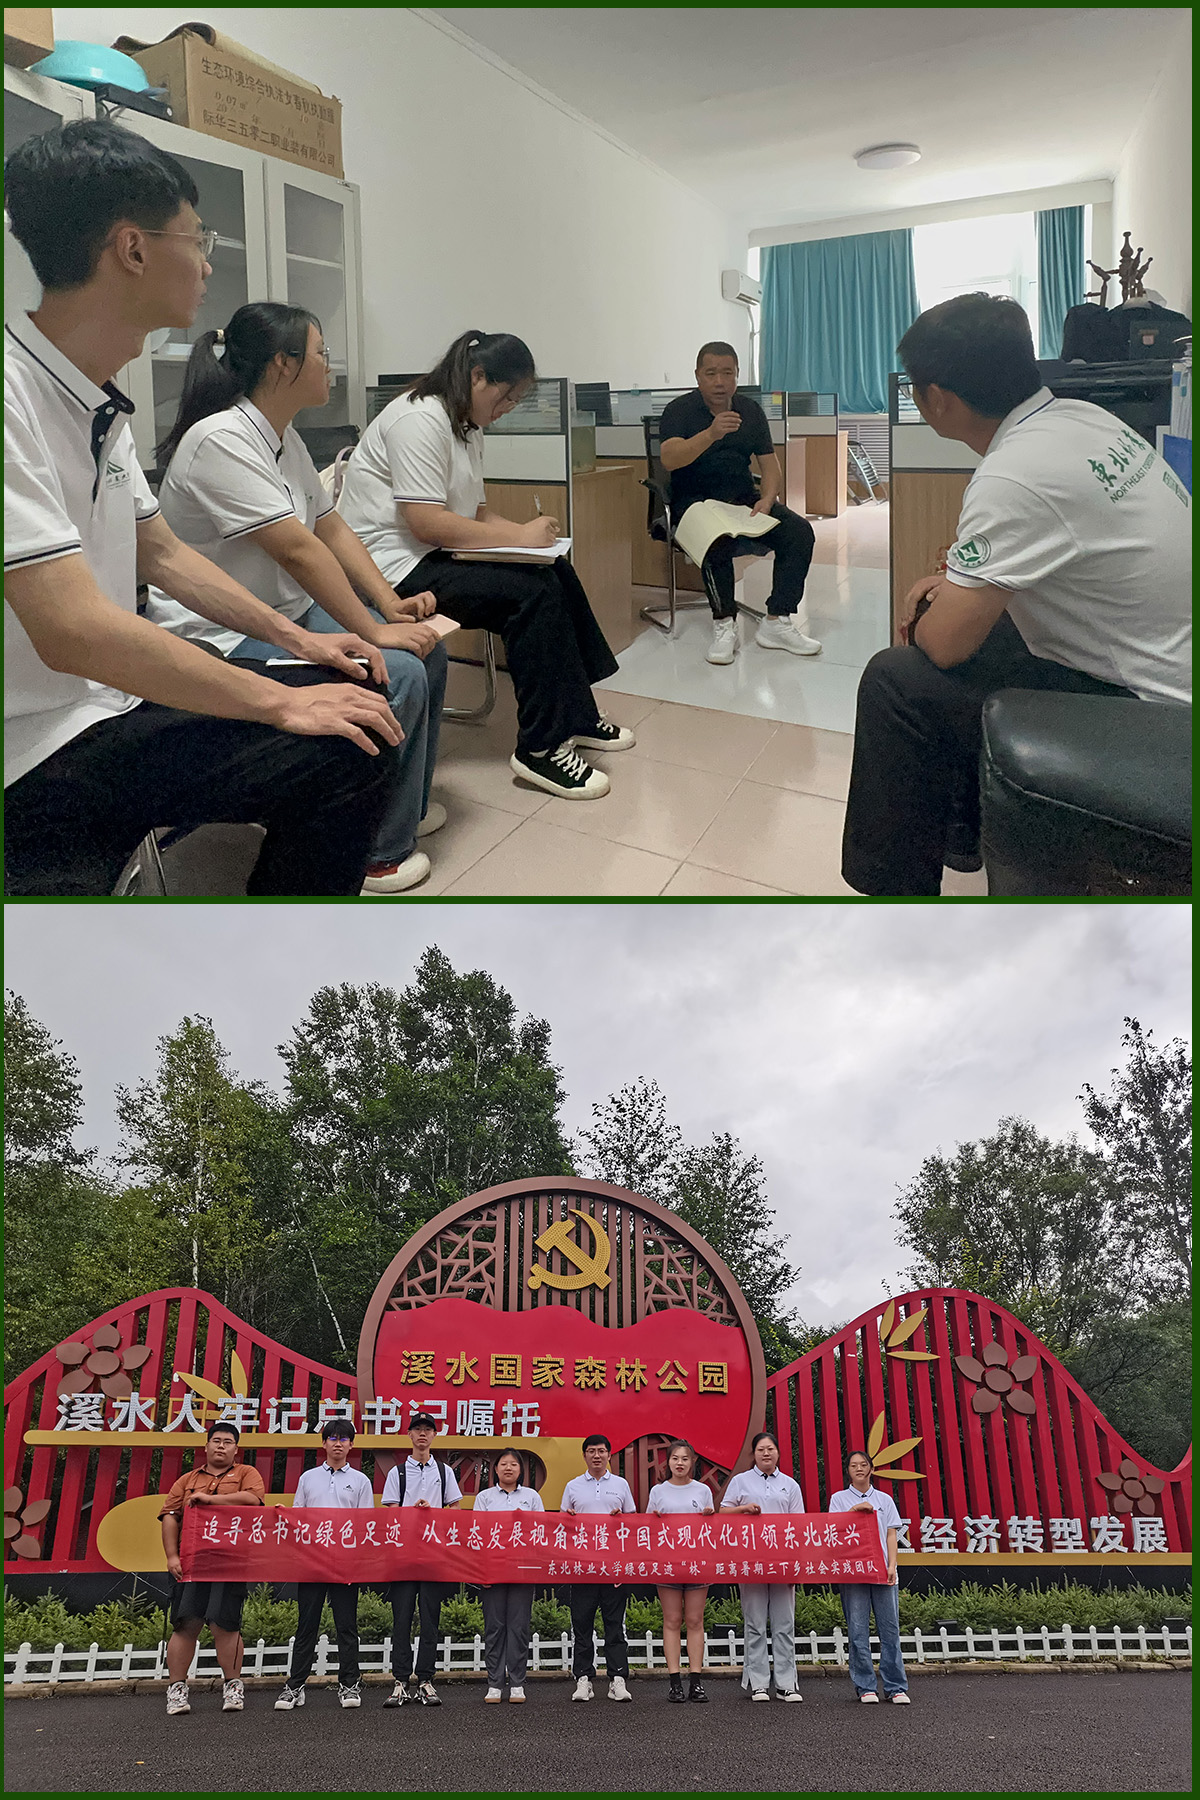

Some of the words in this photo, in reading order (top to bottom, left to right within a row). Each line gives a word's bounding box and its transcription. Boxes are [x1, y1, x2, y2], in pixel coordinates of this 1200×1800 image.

[203, 109, 335, 168] 际华三五零二职业装有限公司
[1109, 467, 1146, 504] NORTHEAST
[400, 1350, 728, 1394] 溪水国家森林公园
[53, 1391, 541, 1437] 溪水人牢记总书记嘱托
[201, 1514, 405, 1549] 追寻总书记绿色足迹
[421, 1518, 861, 1553] 从生态发展视角读懂中国式现代化引领东北振兴
